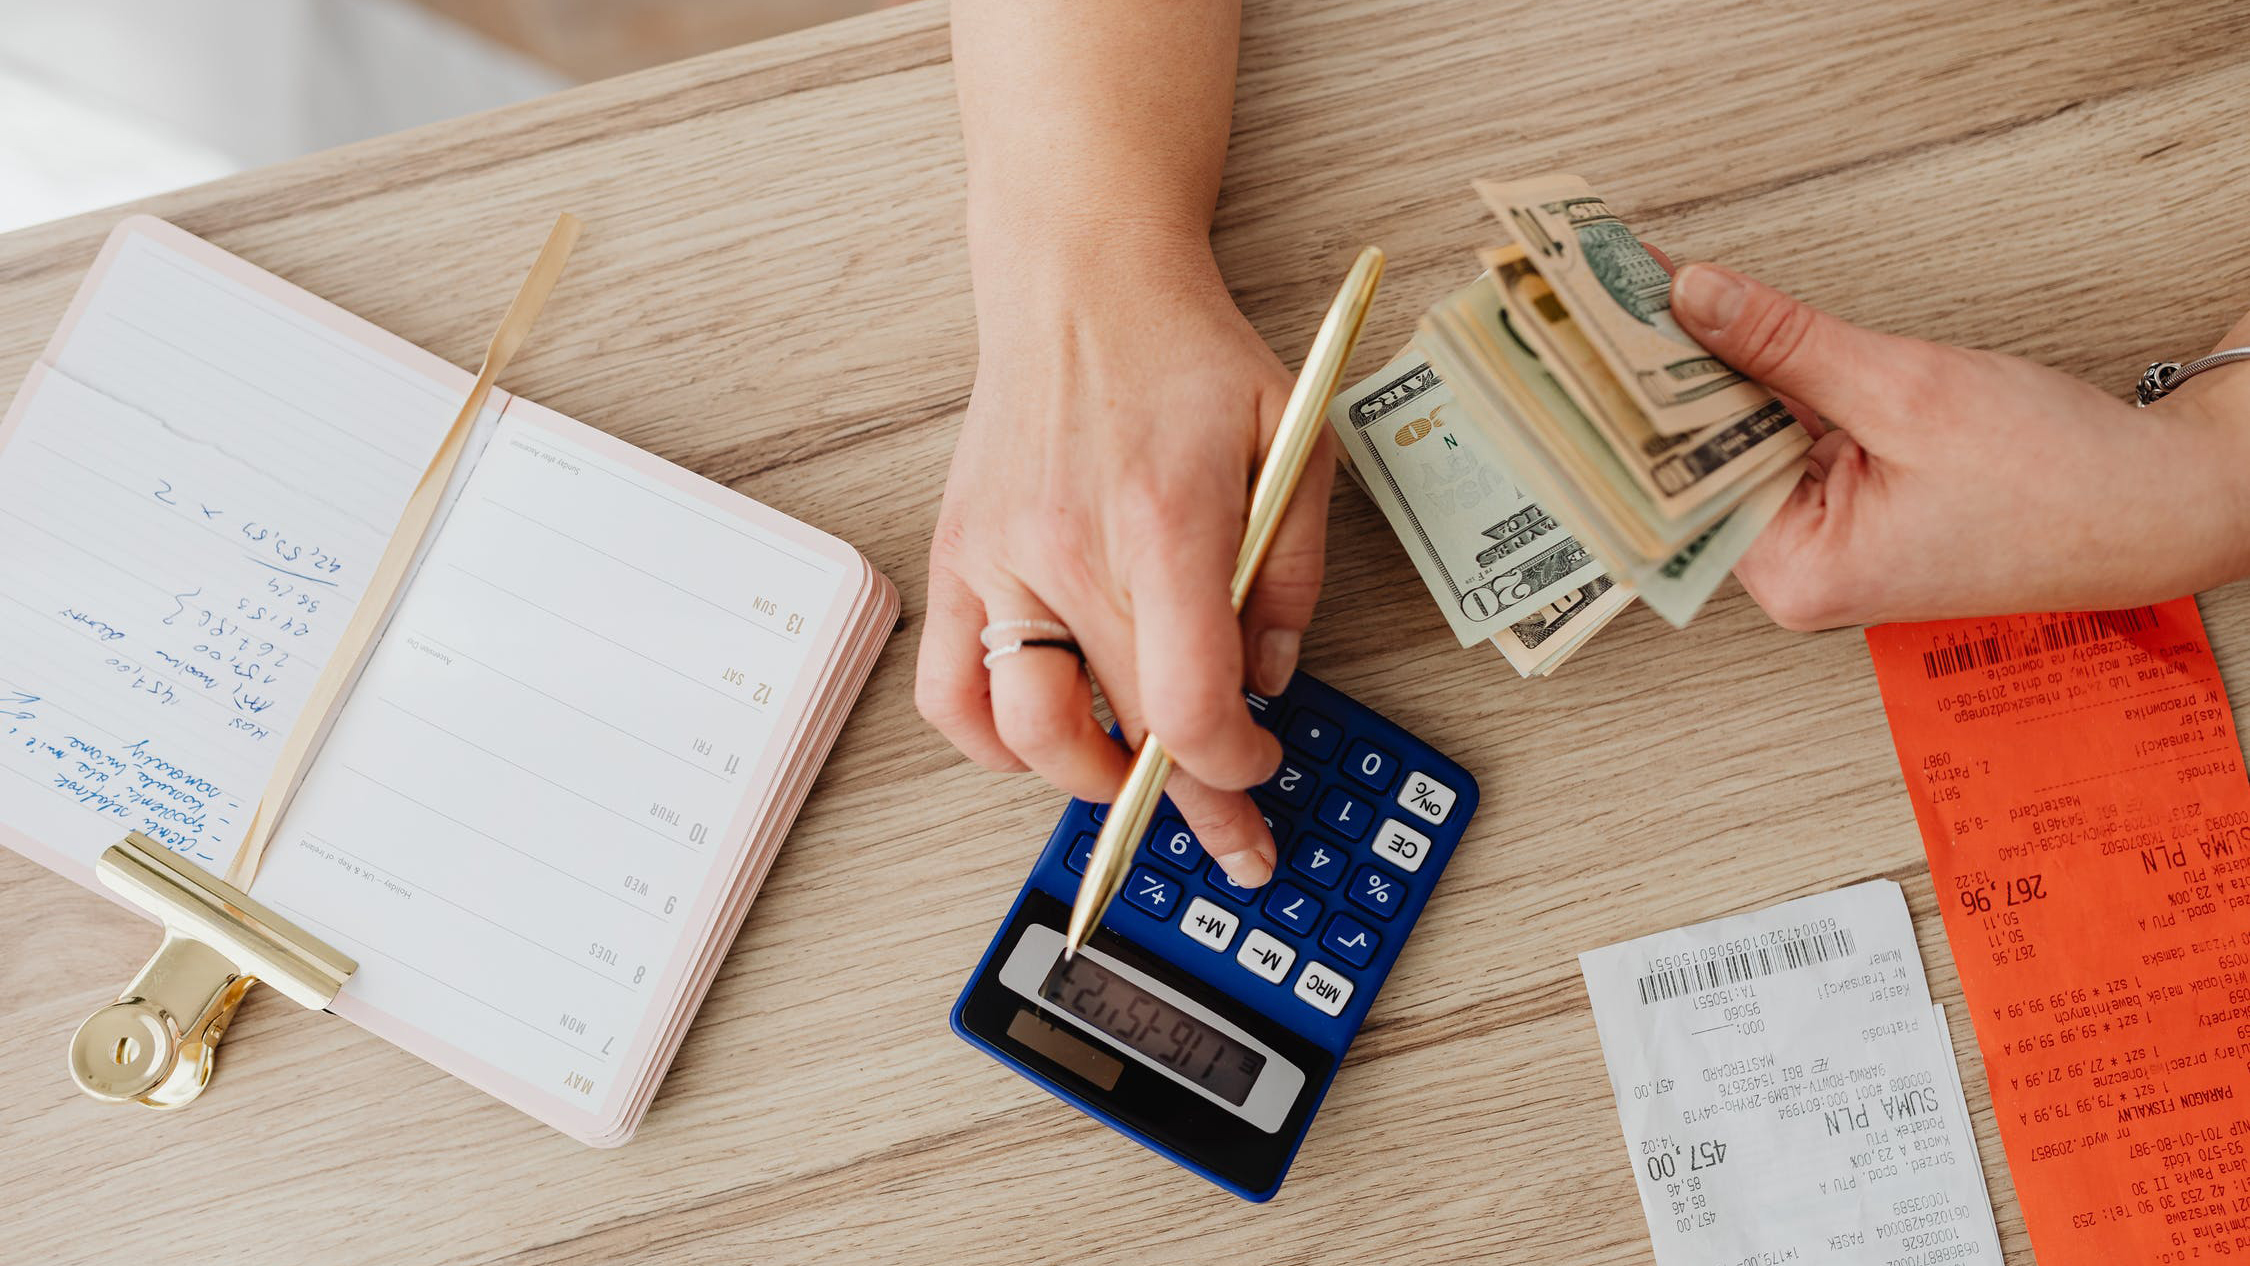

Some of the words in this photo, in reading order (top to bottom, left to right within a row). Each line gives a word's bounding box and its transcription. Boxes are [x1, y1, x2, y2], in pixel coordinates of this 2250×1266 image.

[1442, 433, 1457, 449] N
[1461, 569, 1530, 622] 20
[752, 596, 777, 616] SUN
[786, 613, 805, 635] 13
[2073, 633, 2137, 662] Szczegóły
[2050, 653, 2065, 665] na
[2126, 649, 2155, 667] jest
[722, 667, 745, 686] SAT
[1981, 658, 2044, 681] odwrocie.
[2047, 672, 2062, 686] do
[2137, 657, 2189, 681] Wymiana
[2012, 676, 2042, 693] dnia
[2109, 675, 2131, 690] lub
[753, 682, 772, 705] 12
[2204, 690, 2218, 703] Nr
[1954, 690, 2060, 724] nieuszkodzonego
[2124, 693, 2197, 721] pracownika
[2179, 707, 2222, 726] Kasjer
[2212, 725, 2226, 738] Nr
[692, 738, 713, 756] FRI
[2134, 729, 2205, 757] transakcji
[724, 754, 740, 775] 11
[1923, 751, 1951, 770] 0987
[1276, 766, 1304, 794] 2
[1926, 766, 1970, 786] Patryk
[2177, 759, 2236, 784] Płatność
[1932, 785, 1961, 804] 5817
[650, 802, 680, 827] THUR
[1338, 801, 1352, 821] 1
[2009, 795, 2081, 823] MasterCard
[689, 823, 708, 845] 10
[1954, 817, 1989, 835] -8,95
[1165, 828, 1195, 858] 9
[1387, 832, 1421, 861] CE
[1310, 848, 1330, 869] 4
[2141, 842, 2187, 875] PLN
[624, 875, 649, 896] WED
[1954, 870, 1990, 890] 13:22
[2183, 868, 2207, 885] PTU
[1366, 875, 1391, 903] %
[1960, 874, 2047, 916] 267,96
[2167, 885, 2212, 907] 23,00%
[2216, 882, 2224, 895] A
[664, 896, 677, 914] 9
[1282, 898, 1304, 920] 7
[1196, 915, 1226, 939] M+
[1983, 911, 2019, 931] 50,11
[2138, 919, 2145, 931] A
[2152, 912, 2176, 929] PTU
[1988, 929, 2024, 948] 50,11
[589, 942, 618, 966] TUES
[1869, 948, 1902, 966] Numer
[1992, 944, 2036, 966] 267,96
[2142, 947, 2185, 967] damska
[633, 965, 646, 984] 8
[1893, 966, 1906, 979] Nr
[2188, 970, 2248, 995] Wielopak
[1303, 972, 1343, 1005] MRC
[1817, 971, 1885, 1000] transakcji
[1869, 983, 1910, 1002] Kasjer
[2106, 979, 2128, 995] szt
[2146, 985, 2184, 1005] majek
[1693, 984, 1756, 1010] TA:150551
[2049, 988, 2086, 1009] 99,99
[1724, 1001, 1761, 1021] 95060
[1993, 1008, 2001, 1021] A
[2007, 998, 2044, 1019] 99,99
[2054, 995, 2142, 1026] bawełnianych
[559, 1014, 587, 1035] MON
[1862, 1018, 1919, 1043] Płatność
[2117, 1014, 2138, 1030] szt
[2018, 1033, 2055, 1053] 59,99
[2060, 1024, 2097, 1044] 59,99
[601, 1036, 614, 1055] 7
[2003, 1043, 2011, 1056] A
[2124, 1048, 2146, 1064] szt
[1702, 1053, 1775, 1082] MASTERCARD
[1781, 1064, 1804, 1082] BGI
[2025, 1067, 2062, 1088] 27,99
[2067, 1058, 2104, 1079] 27,99
[563, 1071, 595, 1095] MAY
[1634, 1078, 1674, 1100] 457,00
[2011, 1078, 2018, 1091] A
[2133, 1084, 2155, 1100] szt
[1880, 1087, 1939, 1121] SUMA
[2076, 1093, 2114, 1114] 79,99
[2180, 1085, 2233, 1108] PARAGON
[1824, 1103, 1870, 1137] PLN
[2019, 1113, 2027, 1126] A
[2034, 1103, 2071, 1123] 79,99
[2118, 1098, 2175, 1123] FISKALNY
[1894, 1115, 1945, 1139] Podatek
[2117, 1127, 2131, 1140] nr
[2230, 1119, 2250, 1136] NIP
[1641, 1134, 1675, 1155] 14:02
[1866, 1129, 1889, 1147] PTU
[1913, 1134, 1950, 1151] Kwota
[2031, 1131, 2109, 1162] wydr.209857
[2130, 1126, 2223, 1159] 701-01-80-987
[1644, 1140, 1727, 1181] 457,00
[1849, 1147, 1894, 1169] 23,00%
[1898, 1145, 1906, 1156] A
[2198, 1140, 2244, 1162] 93-570
[2162, 1152, 2191, 1170] Łódź
[2218, 1158, 2248, 1174] Jana
[1833, 1175, 1856, 1192] PTU
[2153, 1176, 2169, 1192] II
[2174, 1166, 2214, 1185] Pawła
[1666, 1176, 1701, 1198] 85,46
[1819, 1182, 1826, 1195] A
[2131, 1181, 2148, 1196] 30
[2181, 1188, 2205, 1205] 253
[2209, 1184, 2225, 1198] 42
[1672, 1194, 1706, 1215] 85,46
[2137, 1199, 2154, 1214] 90
[2159, 1194, 2176, 1210] 30
[1676, 1211, 1716, 1233] 457,00
[2072, 1212, 2096, 1229] 253
[2102, 1204, 2133, 1222] Tel:
[2165, 1203, 2226, 1225] Warszawa
[1827, 1231, 1864, 1251] PASEK
[1902, 1227, 1959, 1252] 10002626
[2171, 1232, 2186, 1246] 19
[2208, 1240, 2231, 1255] Sp.
